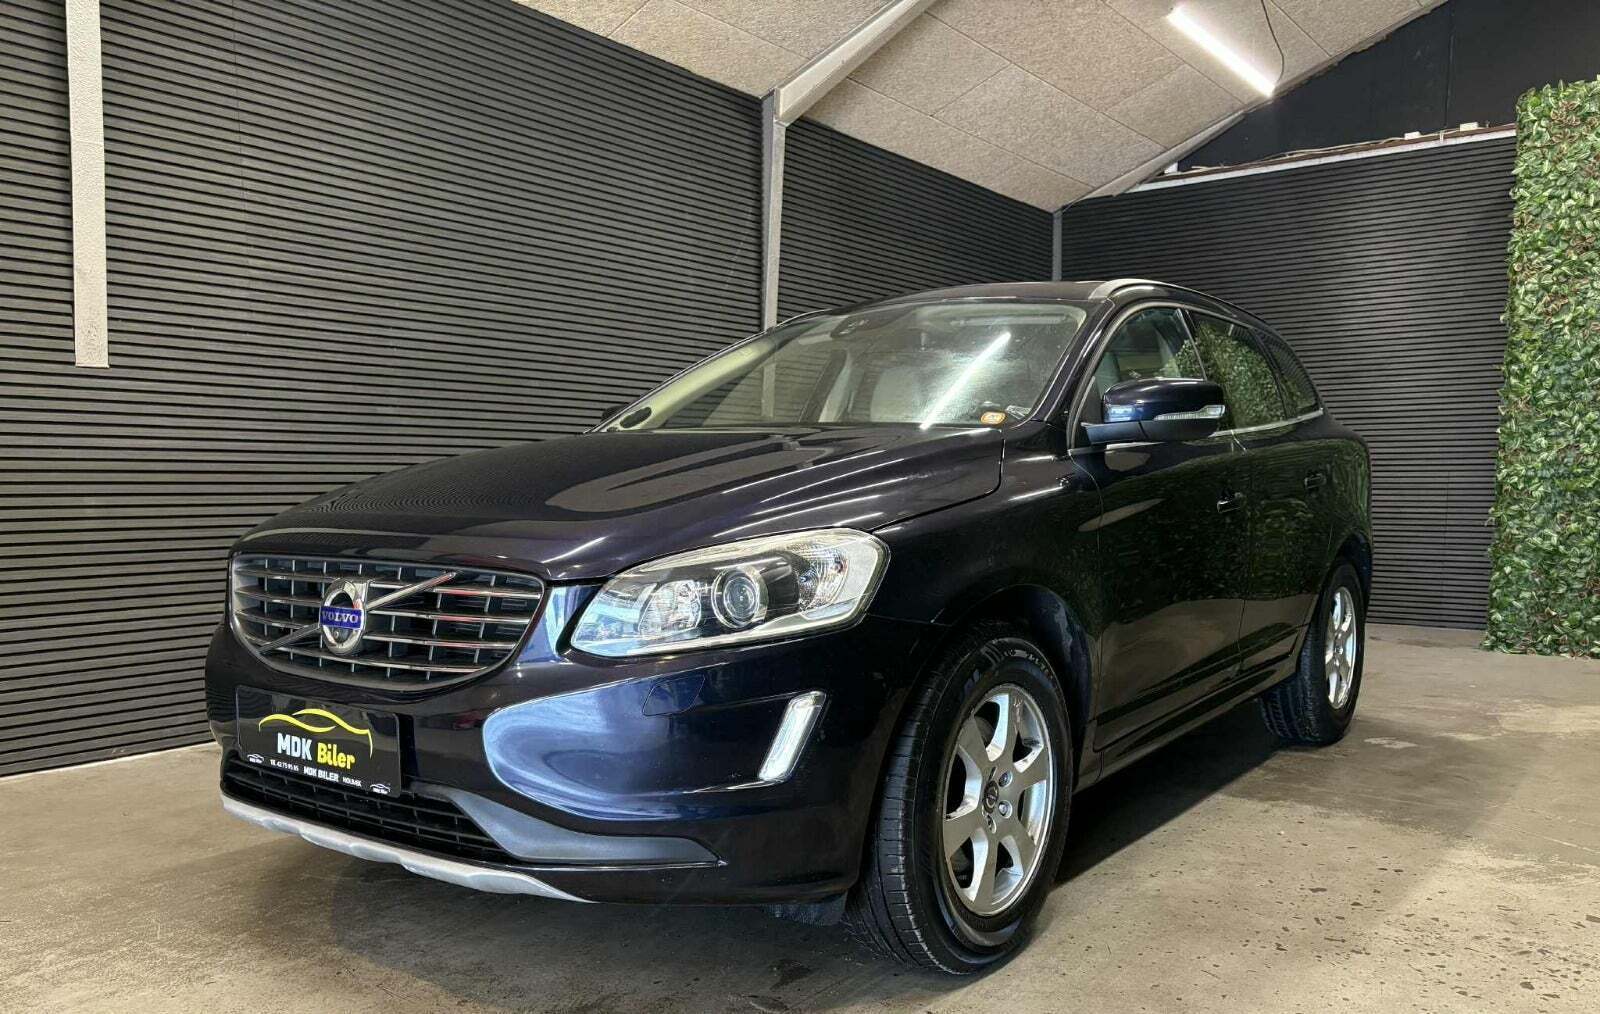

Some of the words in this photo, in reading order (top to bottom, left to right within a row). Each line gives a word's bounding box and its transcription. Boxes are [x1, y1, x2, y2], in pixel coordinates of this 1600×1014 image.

[321, 610, 359, 624] VOLVO
[277, 732, 312, 761] MDK
[317, 742, 355, 769] Biler
[303, 766, 317, 777] MDK
[318, 769, 339, 782] BILER
